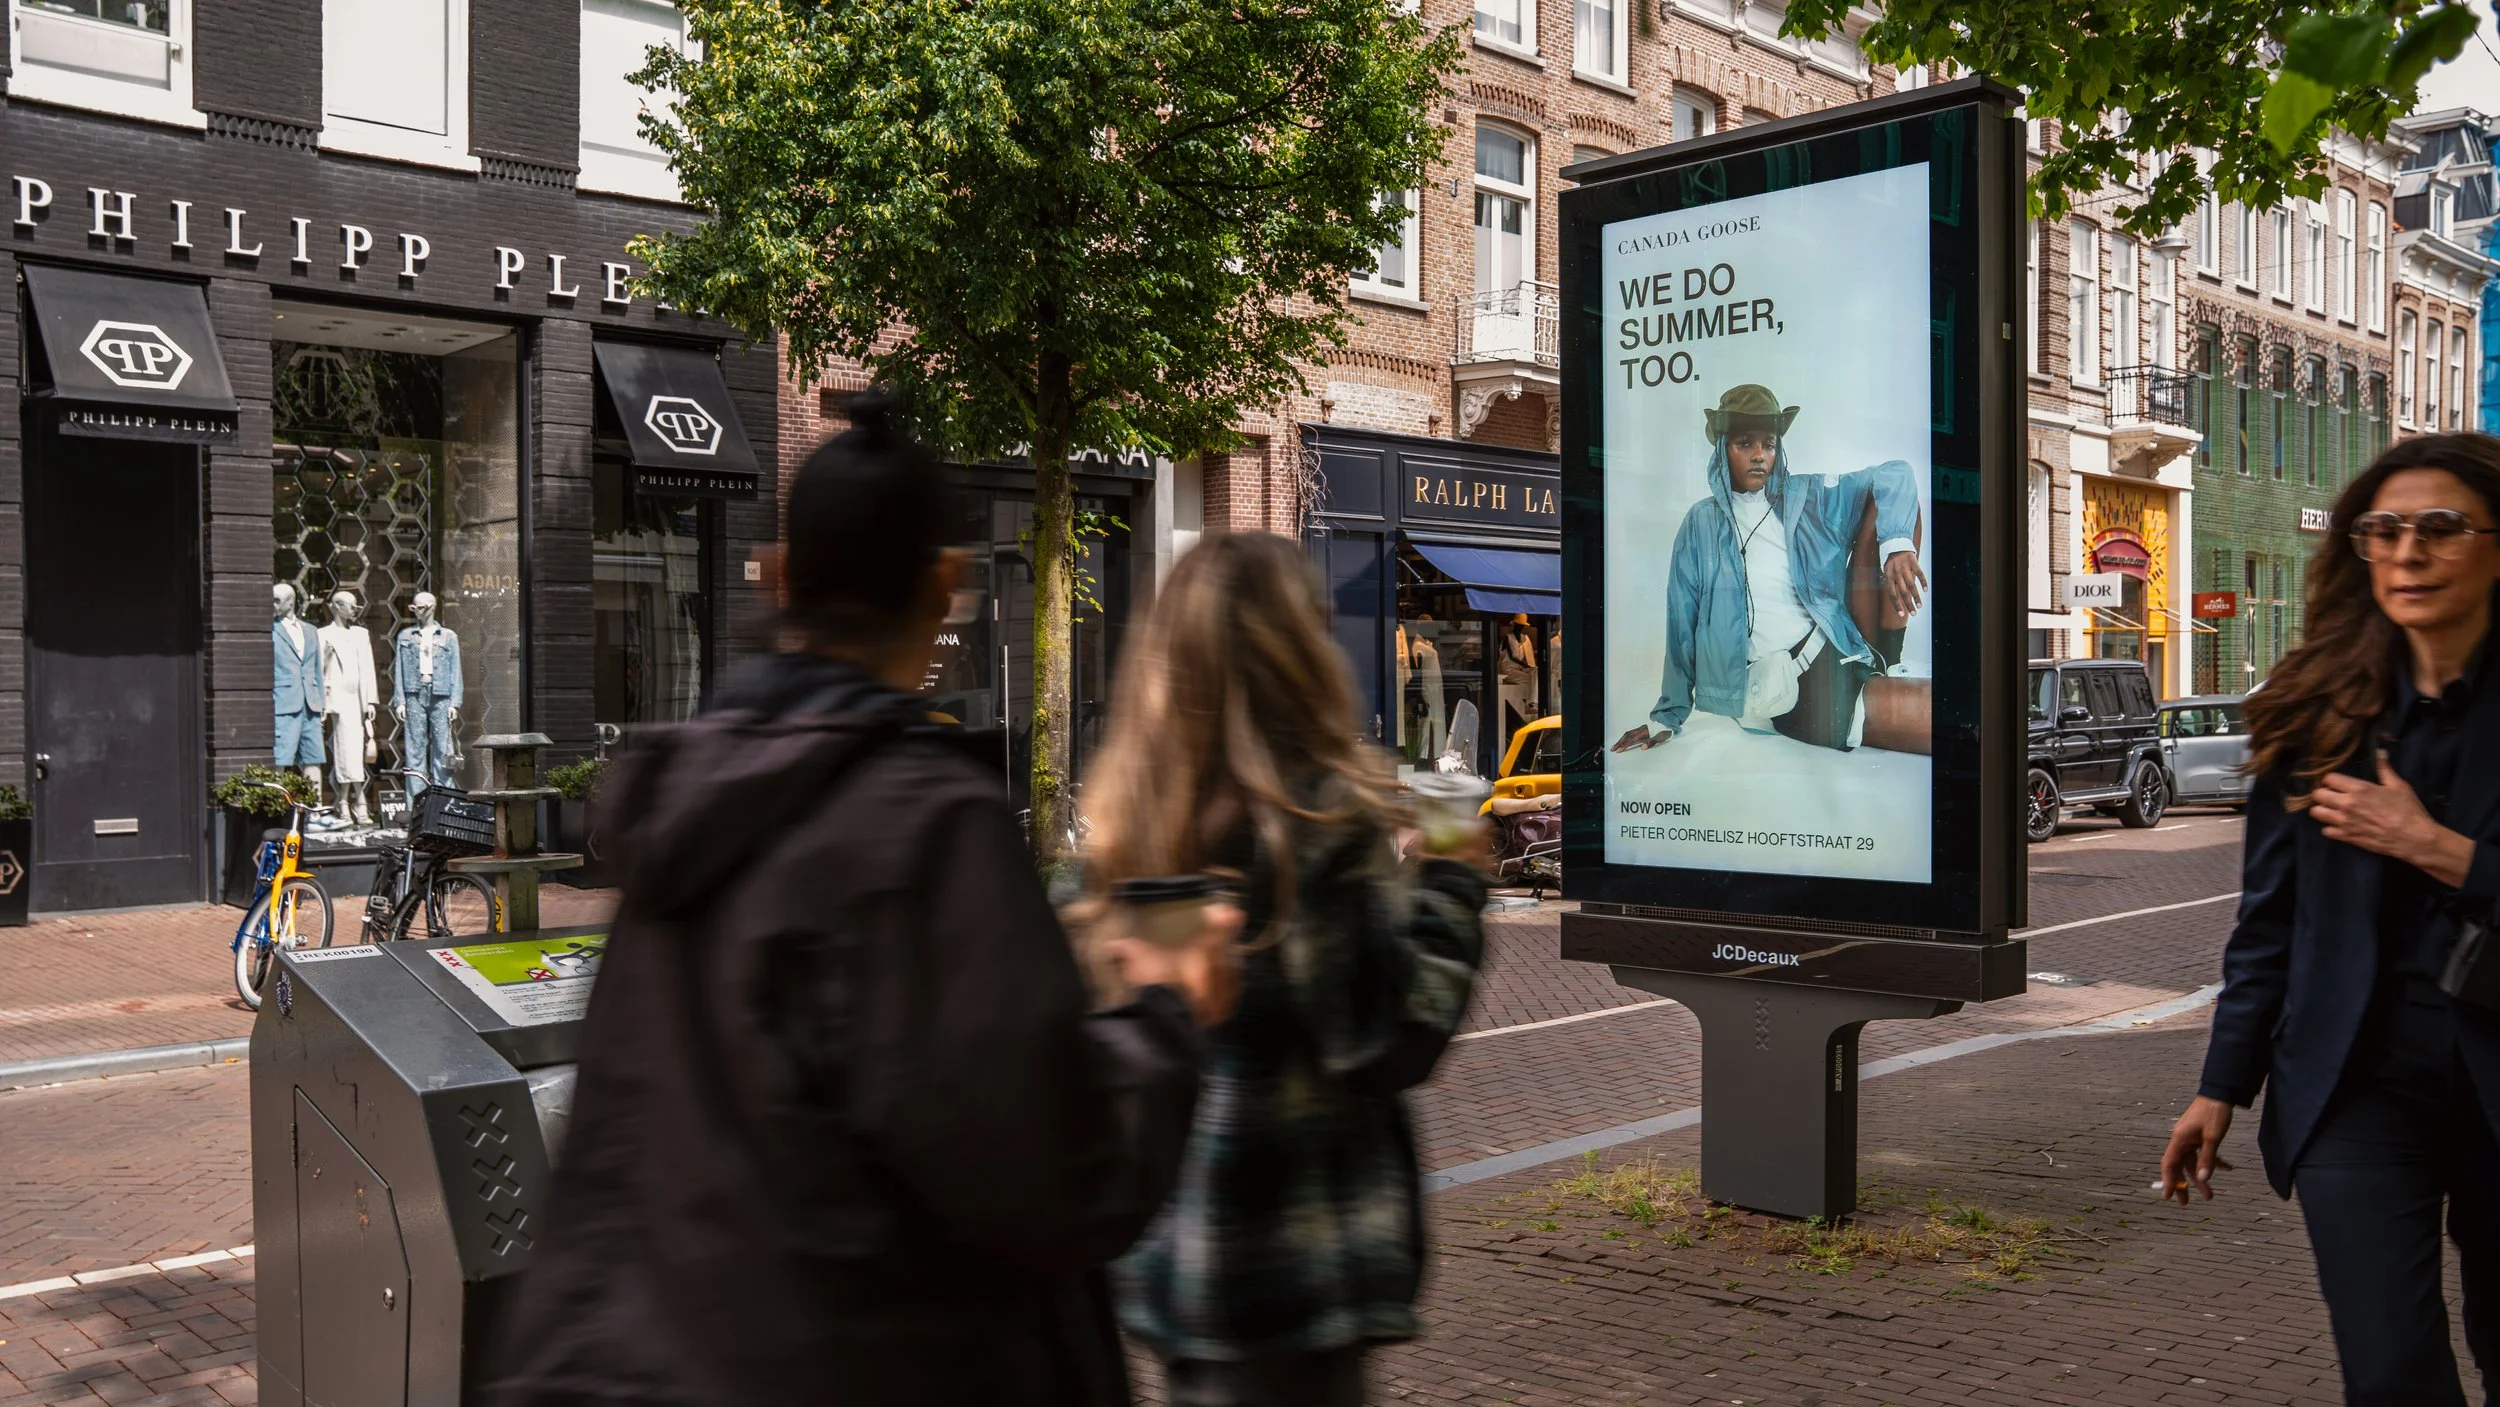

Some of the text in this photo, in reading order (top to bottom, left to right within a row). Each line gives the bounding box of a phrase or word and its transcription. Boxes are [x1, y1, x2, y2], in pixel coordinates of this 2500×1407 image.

[13, 175, 431, 278] PHILIPP
[1618, 215, 1761, 255] CANADA GOOSE
[1619, 263, 1735, 310] WE DO
[1619, 298, 1784, 351] SUMMER,
[1619, 351, 1700, 390] TOO.
[69, 411, 231, 433] PHILIPP PLEIN
[640, 475, 753, 490] PHILIPP PLEIN
[1414, 476, 1509, 511] RALPH
[2074, 585, 2112, 598] DIOR
[381, 802, 407, 813] NEW
[1620, 801, 1691, 816] NOW OPEN
[1620, 825, 1874, 851] PIETER CORNELISZ HOOFTSTRAAT 29
[1712, 944, 1800, 967] JCDecaux
